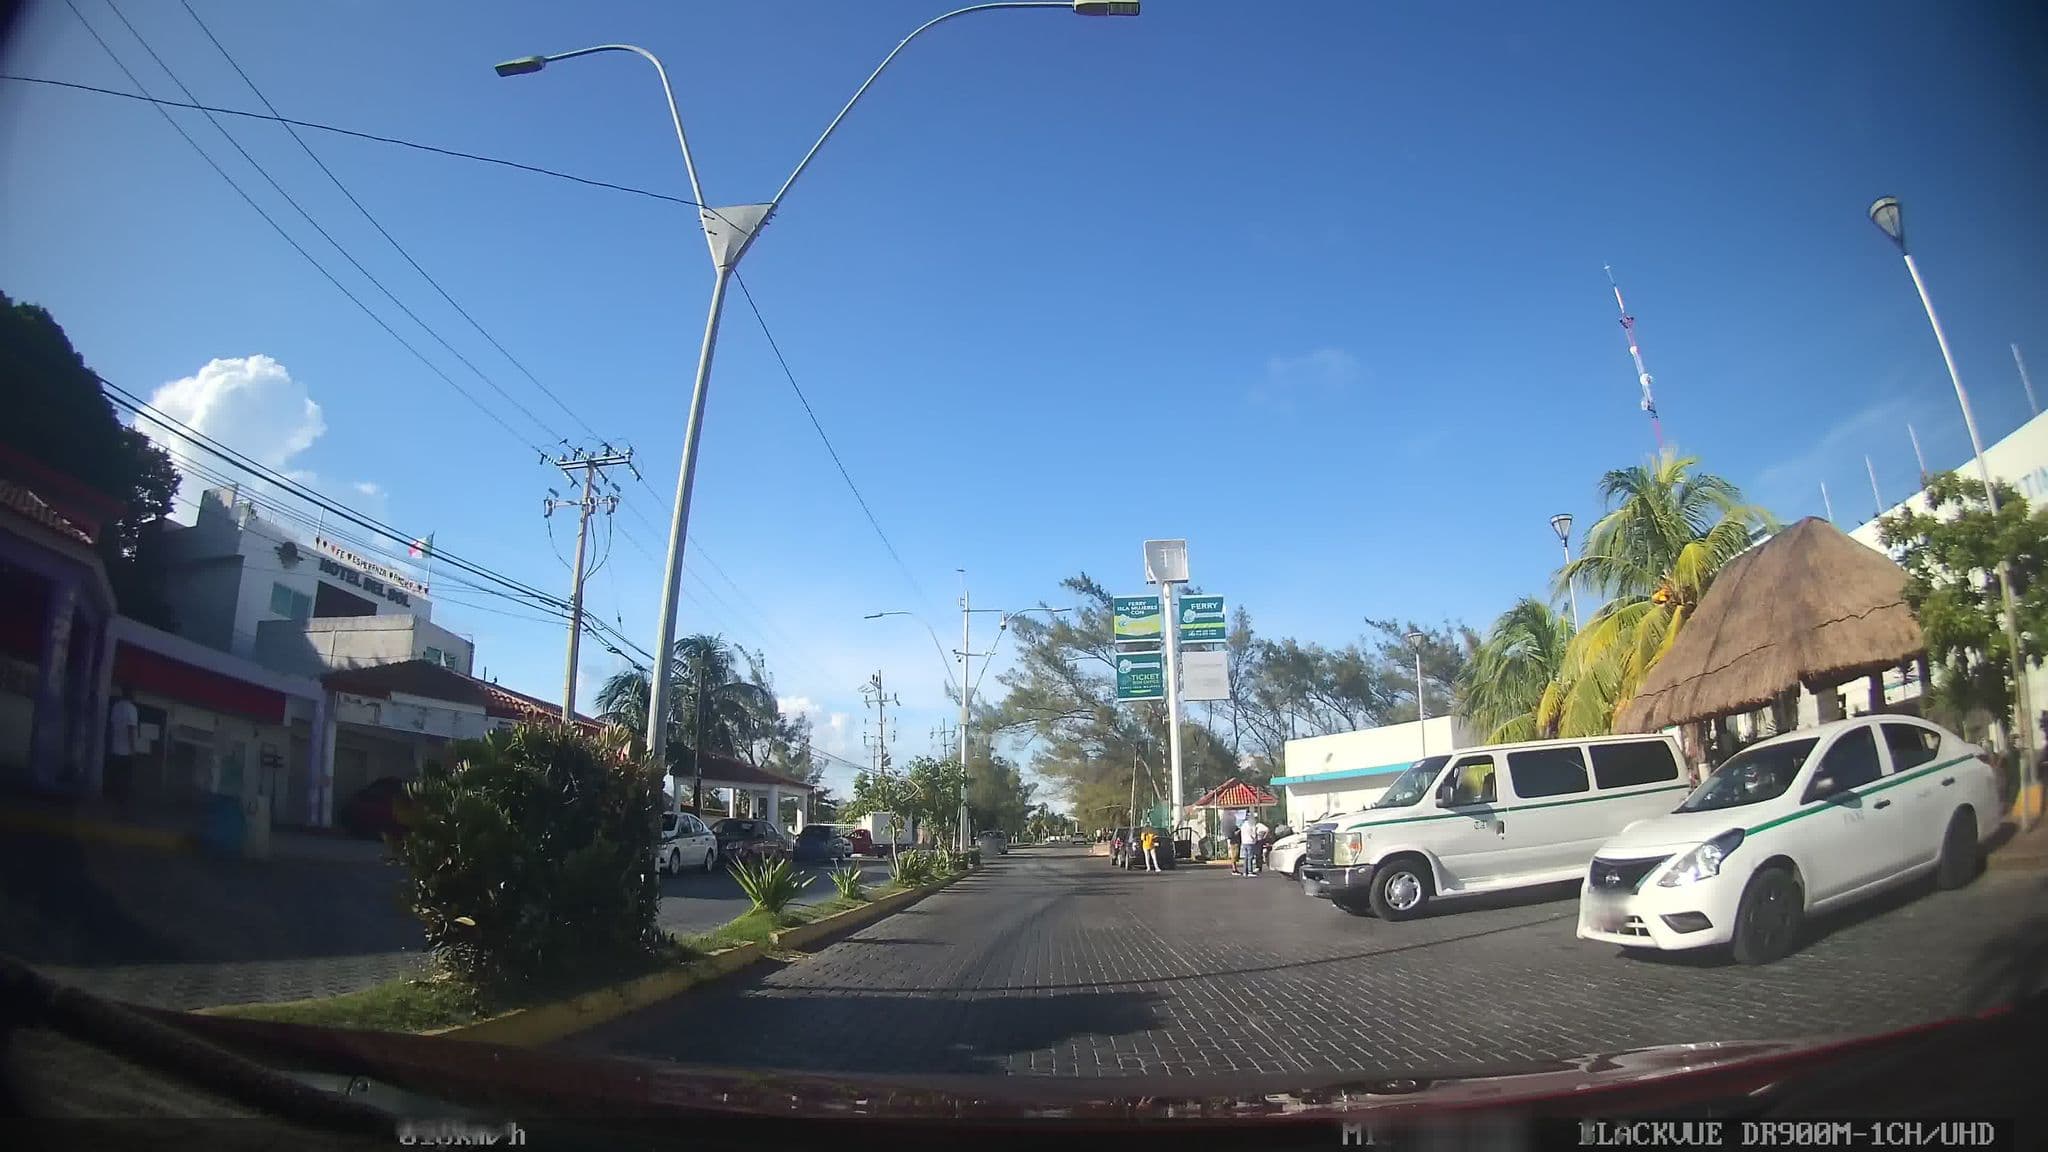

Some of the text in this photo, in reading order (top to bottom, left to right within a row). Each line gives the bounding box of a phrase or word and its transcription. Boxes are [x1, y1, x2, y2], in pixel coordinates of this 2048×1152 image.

[319, 559, 411, 608] HOTEL DEL SOL
[1190, 602, 1218, 610] FERRY
[1131, 673, 1160, 681] TICKET
